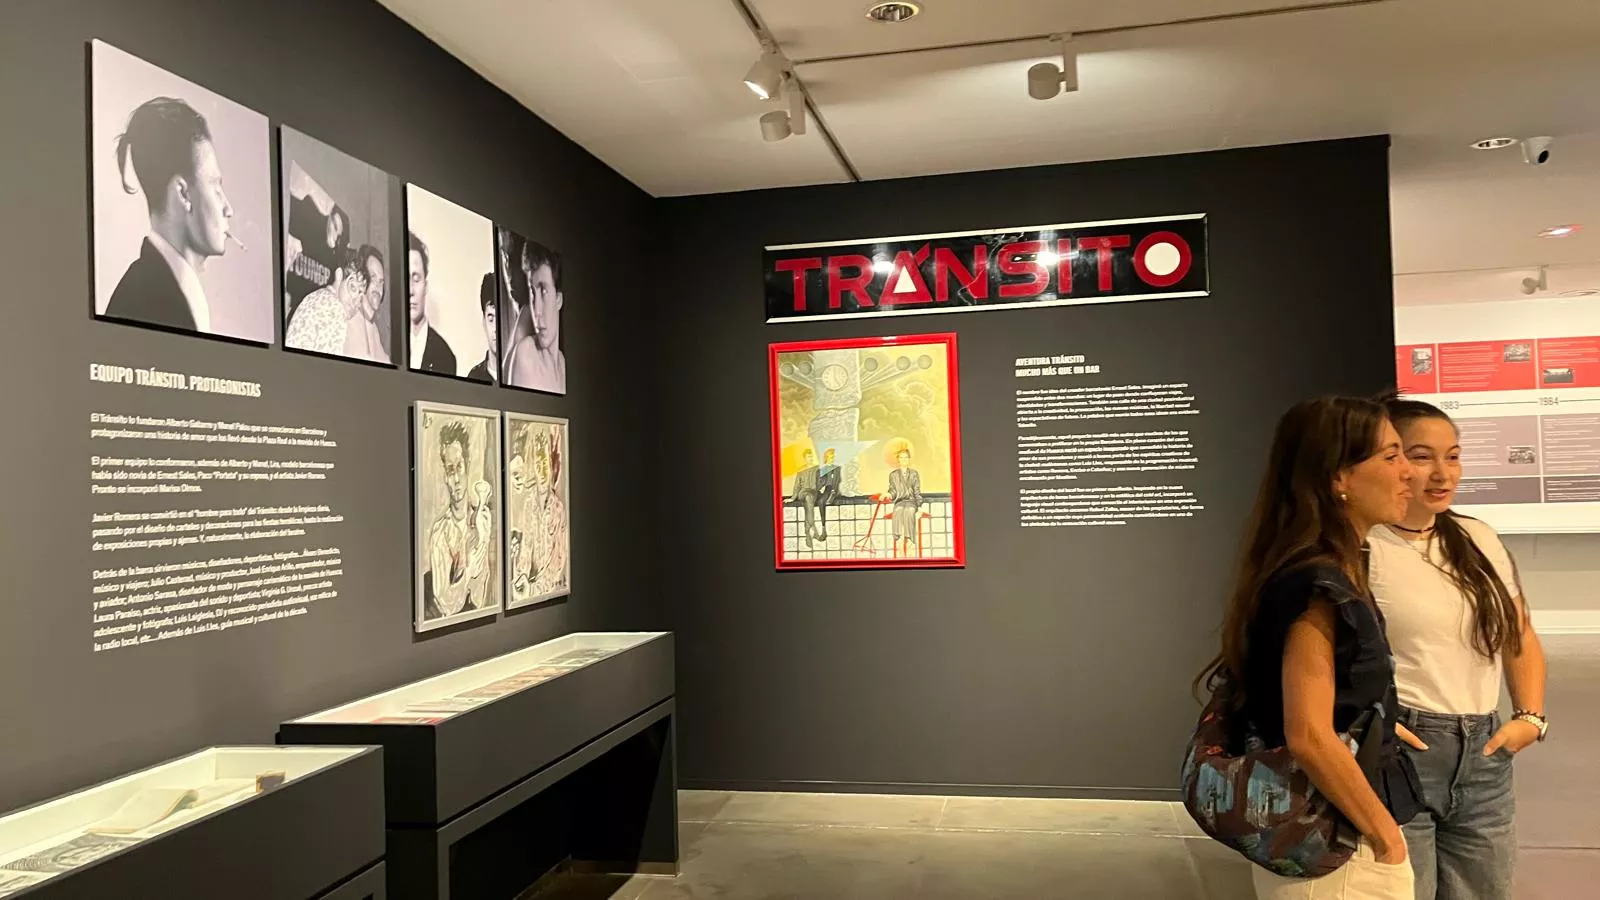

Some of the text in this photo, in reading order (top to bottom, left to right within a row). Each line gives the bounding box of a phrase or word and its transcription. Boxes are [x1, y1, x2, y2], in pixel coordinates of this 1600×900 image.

[775, 231, 1192, 311] TRÁNSITO
[1015, 365, 1099, 377] MUCHO MÁS QUE UN BAR
[1016, 354, 1084, 366] AVENTURA TRÁNSITO
[90, 363, 261, 398] EQUIPO TRÁNSITO. PROTAGONISTAS
